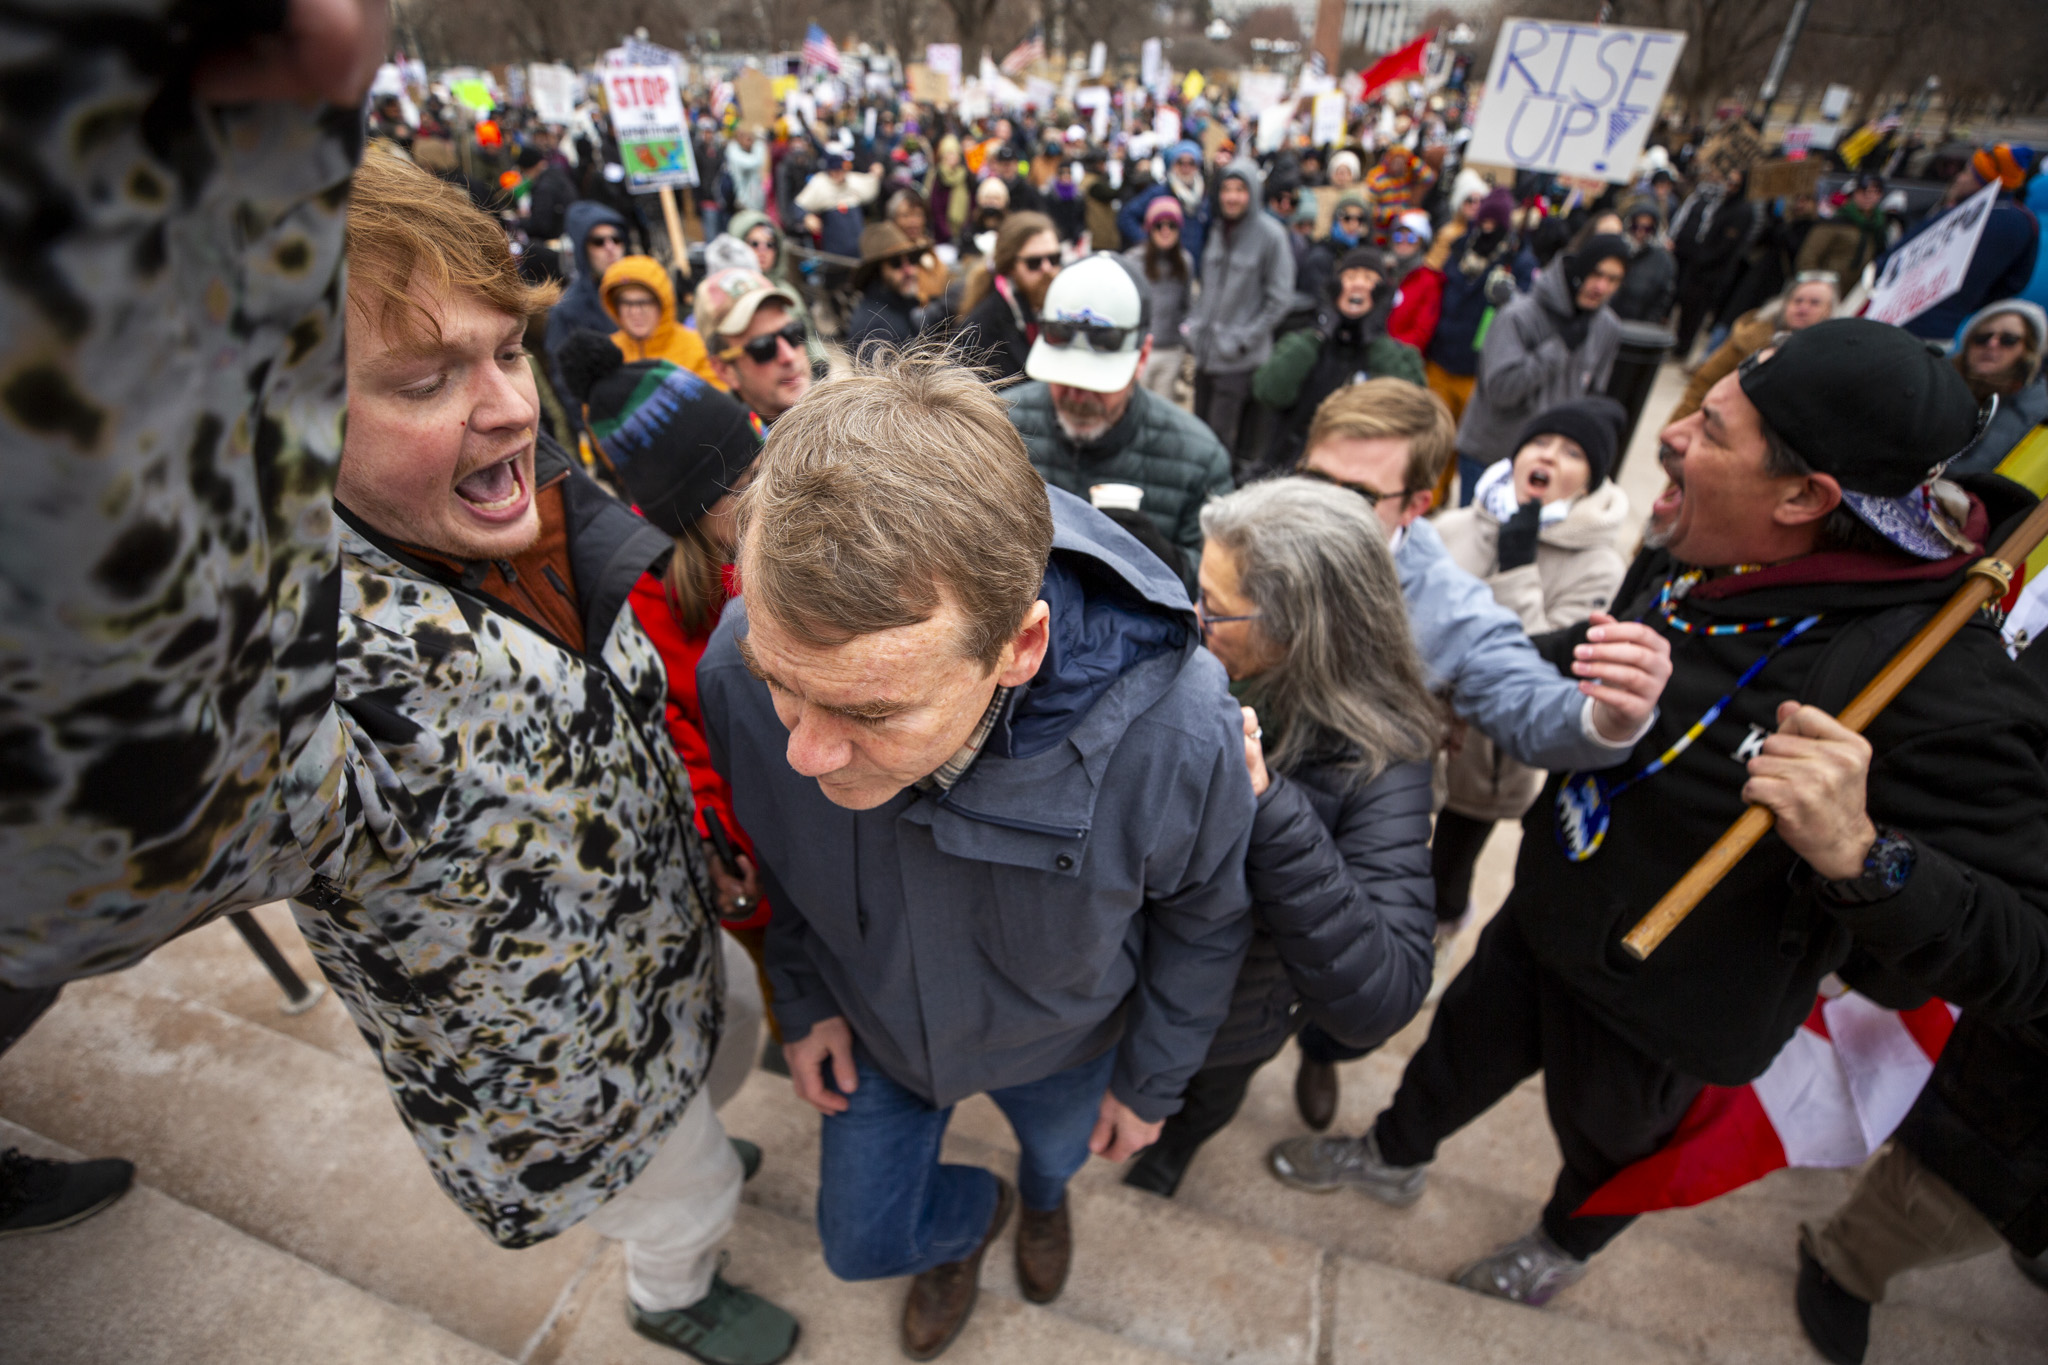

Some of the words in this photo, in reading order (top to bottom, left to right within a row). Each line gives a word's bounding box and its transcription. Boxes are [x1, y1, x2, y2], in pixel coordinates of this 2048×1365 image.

[612, 75, 670, 109] STOP
[1497, 20, 1675, 114] RISE
[1504, 99, 1641, 173] UP!
